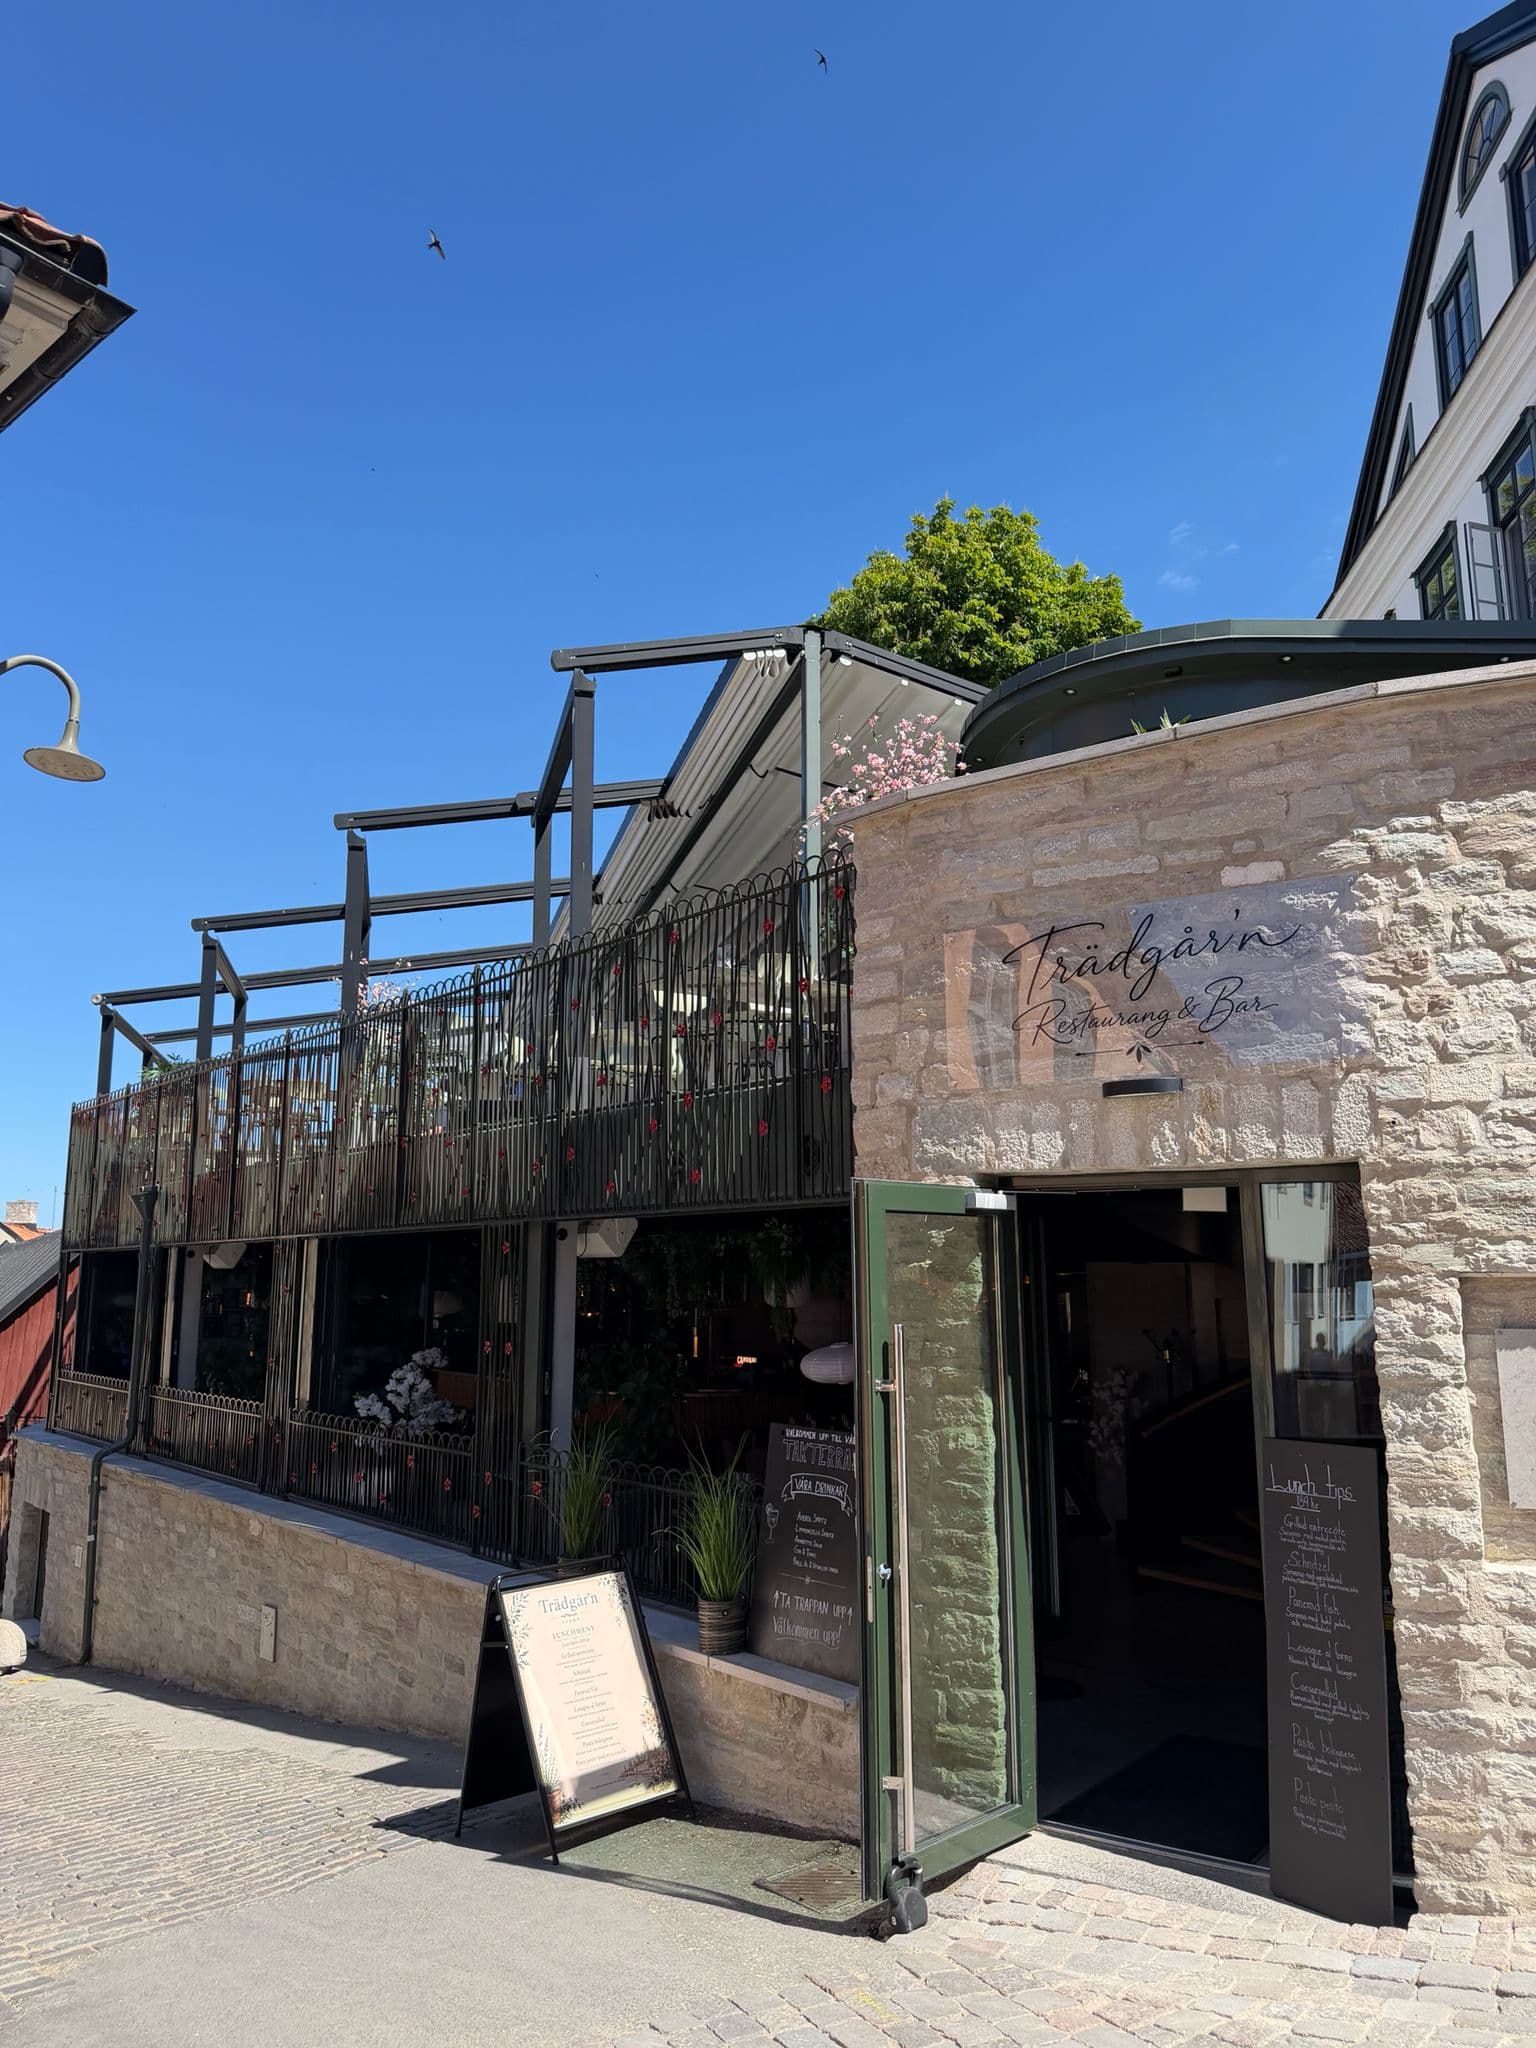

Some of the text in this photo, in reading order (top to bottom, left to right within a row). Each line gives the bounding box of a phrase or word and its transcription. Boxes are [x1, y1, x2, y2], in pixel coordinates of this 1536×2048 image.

[1003, 908, 1301, 1005] Trädgår'n
[1013, 976, 1279, 1047] Restaurang & Bar
[794, 1476, 845, 1498] VÅRA DRINKAR
[1270, 1464, 1318, 1496] Lunch
[1288, 1551, 1330, 1572] Schnitzel
[780, 1592, 847, 1618] TA TRAPPAN UPP
